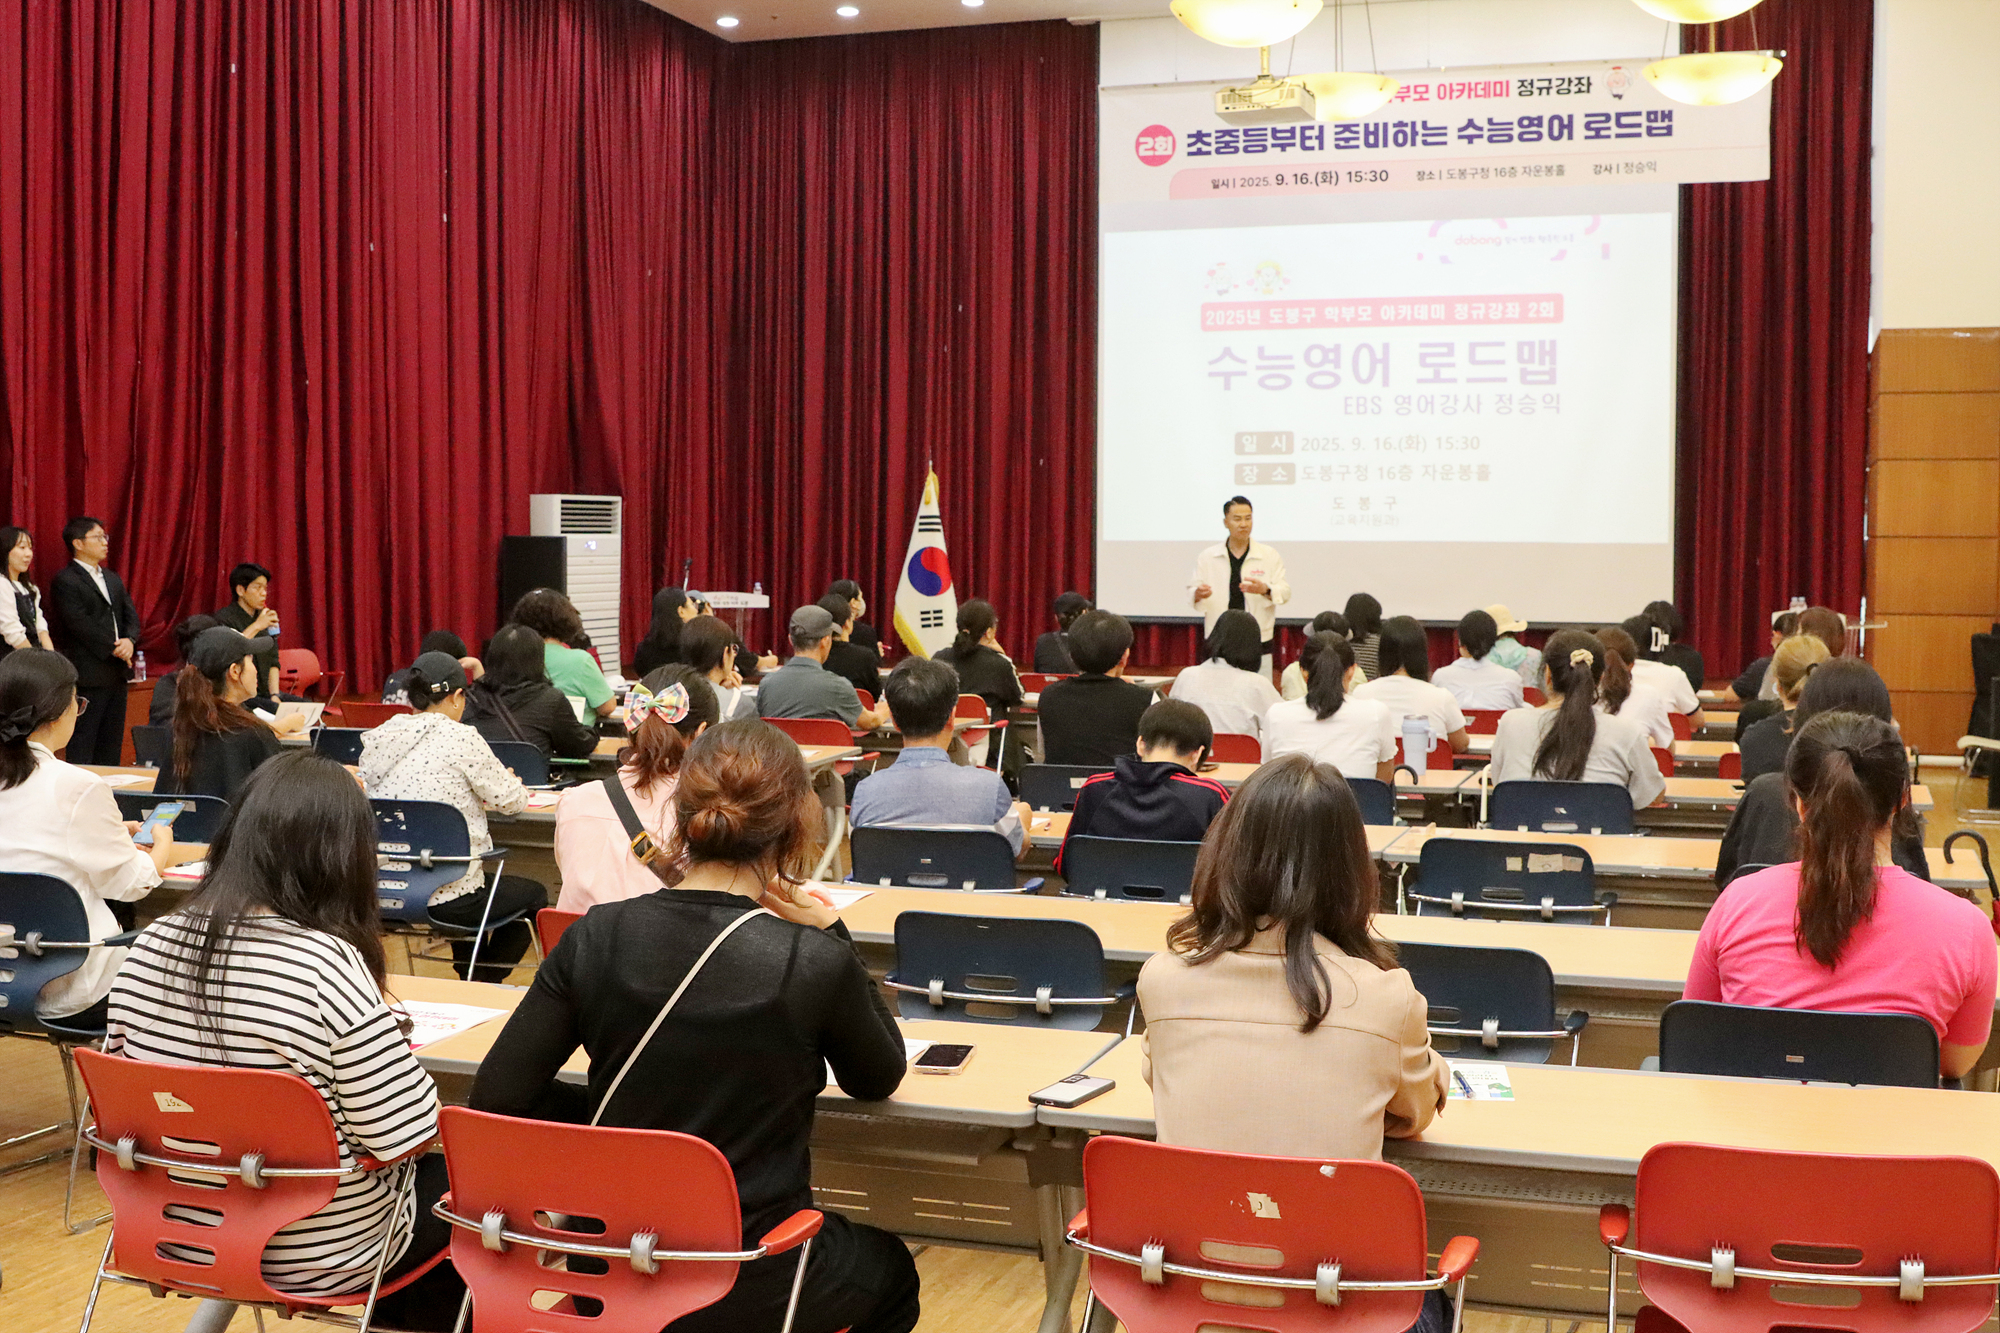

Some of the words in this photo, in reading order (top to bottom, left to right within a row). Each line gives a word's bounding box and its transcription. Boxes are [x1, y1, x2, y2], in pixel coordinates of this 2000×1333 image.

[1388, 84, 1430, 103] 부모
[1437, 80, 1510, 100] 아카데미
[1517, 76, 1593, 97] 정규강좌
[1187, 125, 1325, 156] 초중등부터
[1334, 120, 1448, 150] 준비하는
[1457, 114, 1575, 145] 수능영어
[1583, 109, 1674, 140] 로드맵
[1138, 135, 1173, 157] 2회
[1416, 170, 1435, 182] 장소
[1446, 167, 1490, 180] 도봉구청
[1494, 166, 1517, 178] 16층
[1521, 164, 1566, 178] 자운봉홀
[1593, 163, 1613, 175] 강사
[1623, 161, 1658, 174] 정승익
[1211, 177, 1230, 190] 일시
[1240, 176, 1273, 189] 2025.
[1346, 169, 1389, 183] 15:30
[1206, 309, 1261, 326] 2025년
[1269, 307, 1316, 324] 도봉구
[1324, 305, 1372, 323] 학부모
[1380, 303, 1445, 321] 아카데미
[1454, 301, 1520, 320] 정규강좌
[1528, 301, 1555, 318] 2회
[1207, 342, 1390, 392] 수능영어
[1416, 339, 1557, 386] 로드맵
[1344, 395, 1382, 415] EBS
[1394, 394, 1483, 416] 영어강사
[1495, 393, 1561, 416] 정승익
[1301, 437, 1345, 452] 2025.
[1436, 436, 1480, 451] 15:30
[1301, 464, 1368, 482] 도봉구청
[1378, 463, 1413, 482] 16층
[1421, 463, 1492, 482] 자운봉홀
